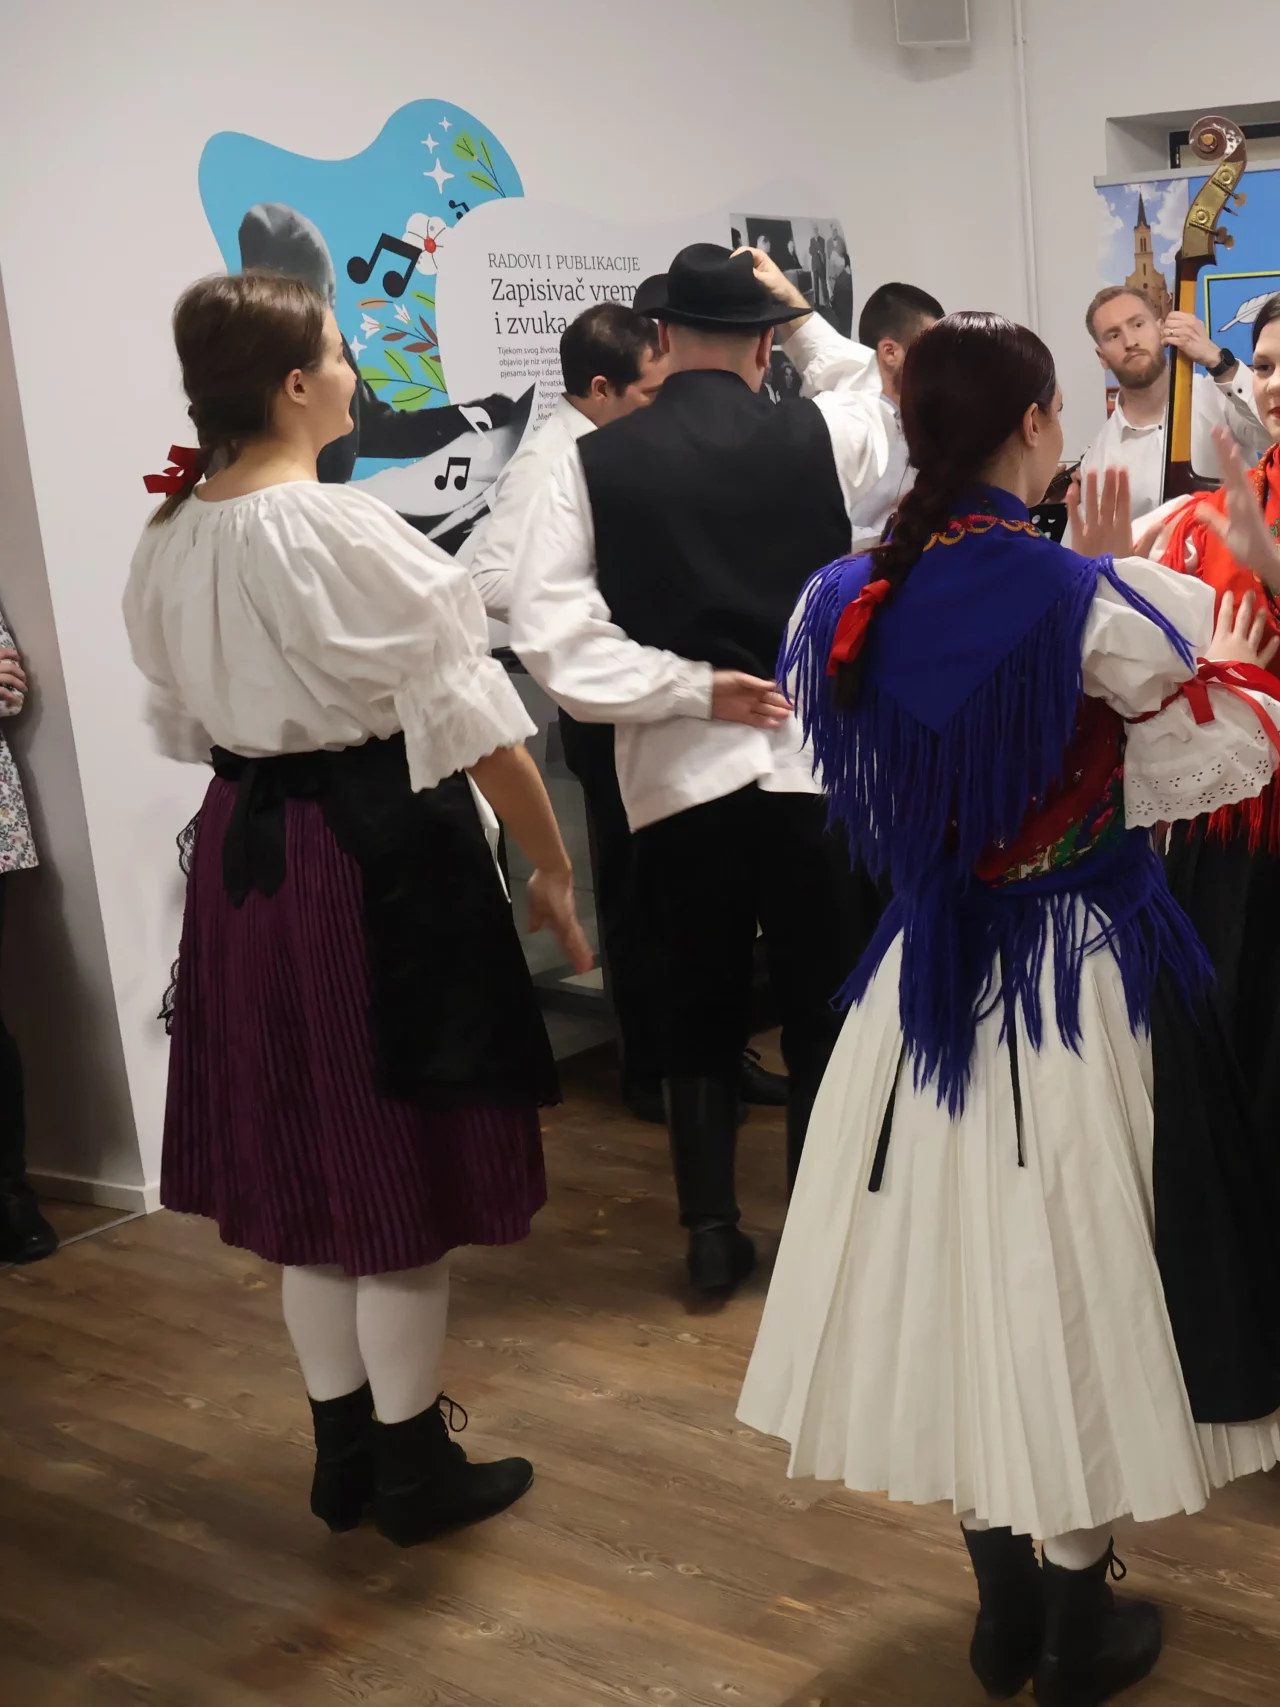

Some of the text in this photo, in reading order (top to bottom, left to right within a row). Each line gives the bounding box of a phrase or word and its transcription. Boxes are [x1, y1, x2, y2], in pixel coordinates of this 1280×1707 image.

[488, 253, 641, 273] RADOVI I PUBLIKACIJE
[491, 277, 638, 307] Zapisivač vrem
[494, 310, 568, 335] i zvuka
[498, 347, 522, 356] Tijekom
[524, 348, 538, 356] svog
[499, 358, 522, 368] objavio
[541, 357, 561, 367] vrijedn
[500, 370, 526, 379] pjesama
[528, 369, 540, 378] koje
